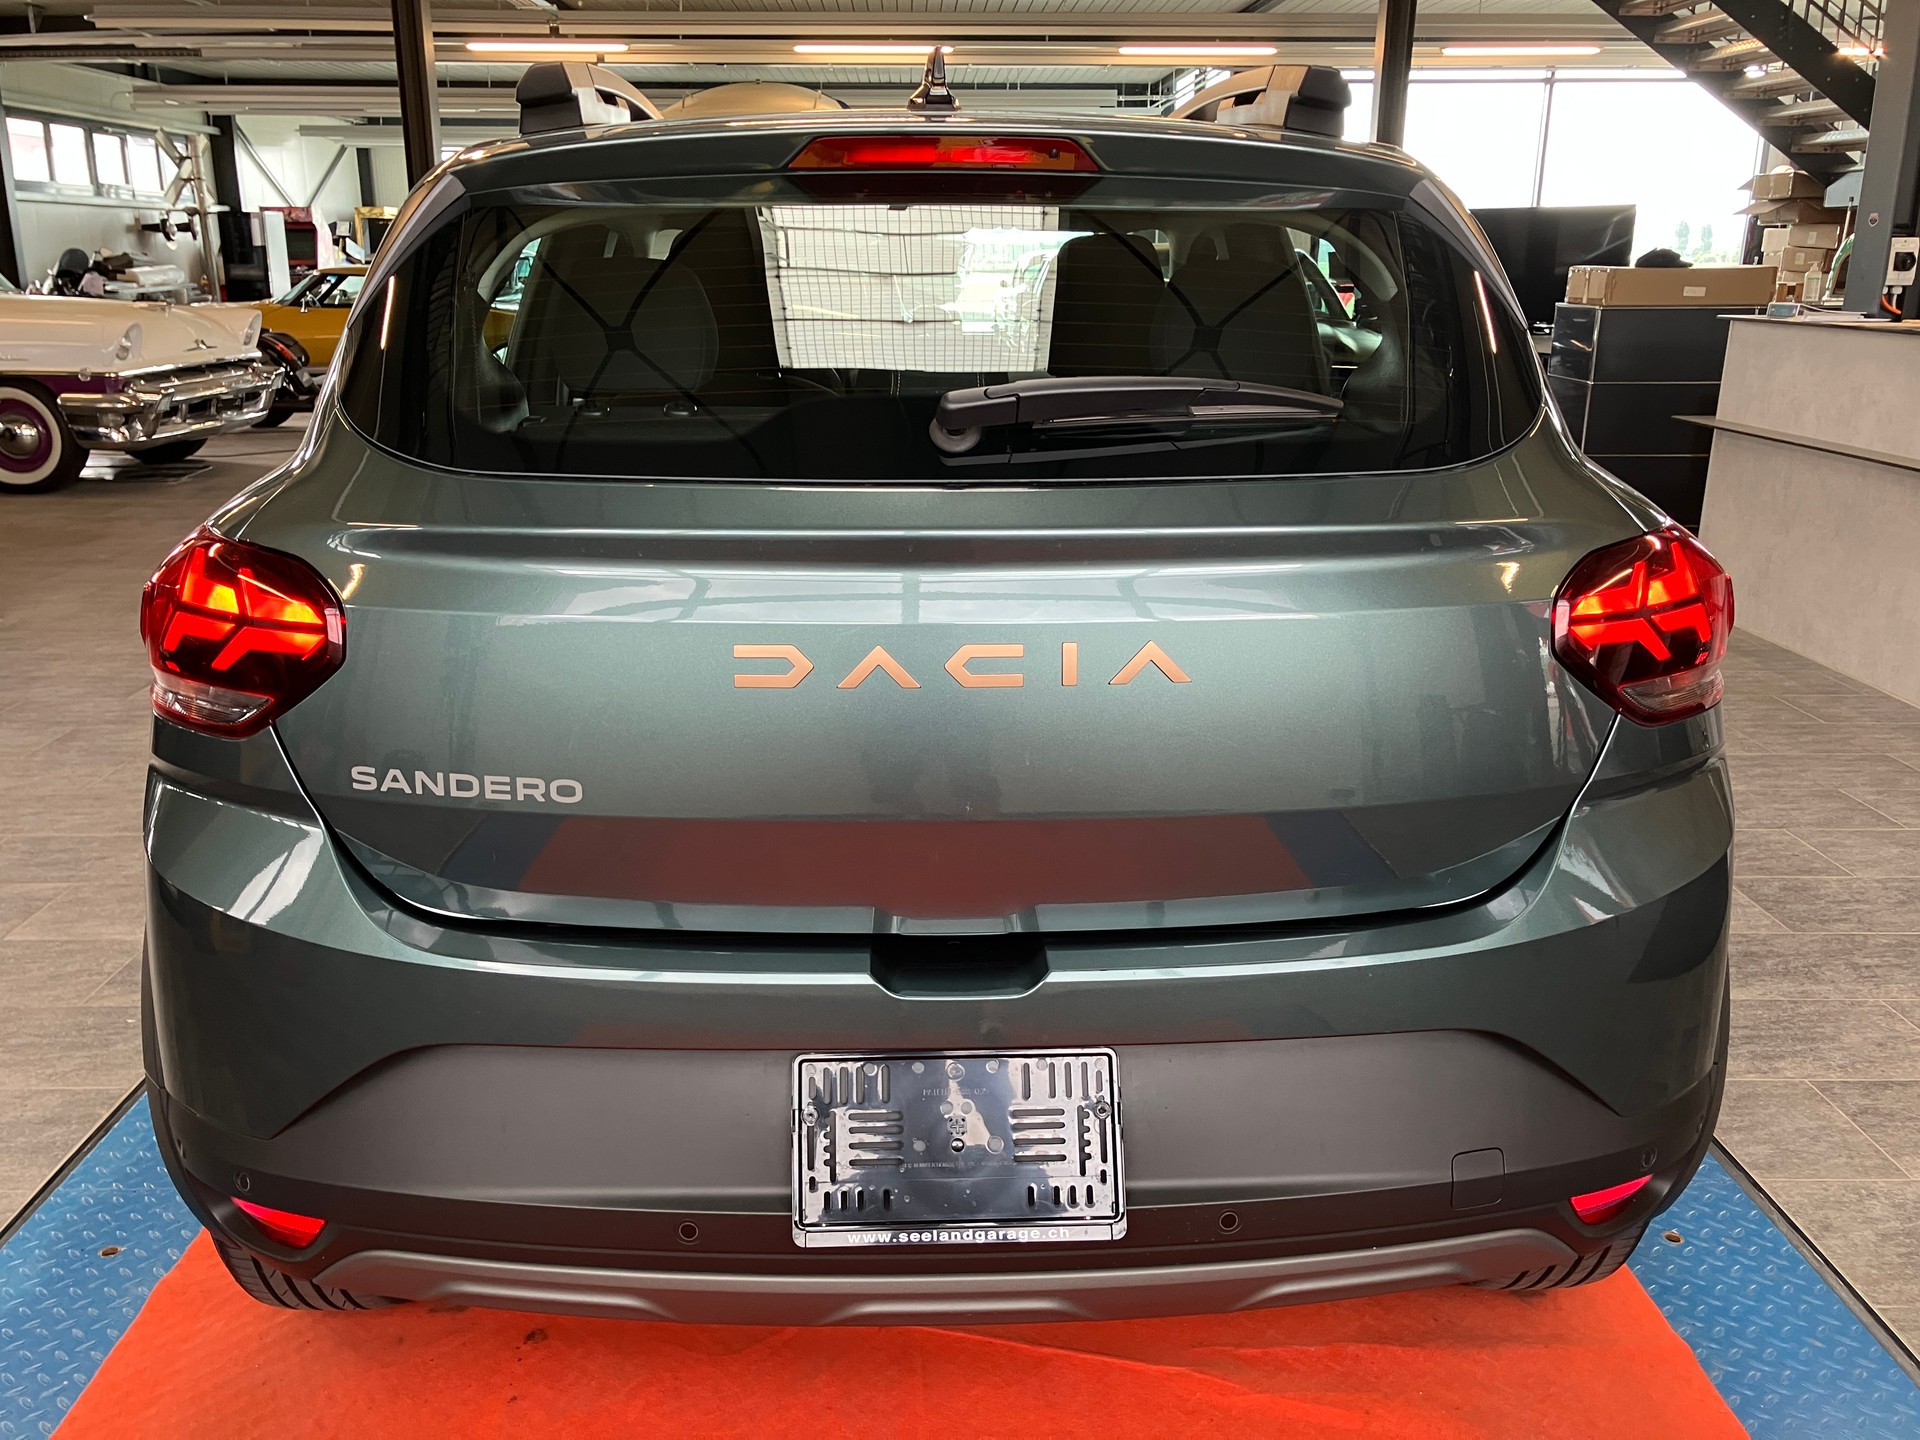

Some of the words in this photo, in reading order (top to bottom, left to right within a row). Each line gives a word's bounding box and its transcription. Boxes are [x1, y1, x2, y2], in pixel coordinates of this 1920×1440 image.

[733, 639, 1192, 689] DACIA
[350, 765, 584, 804] SANDERO
[847, 1227, 1070, 1245] www.seelandgarage.ch
